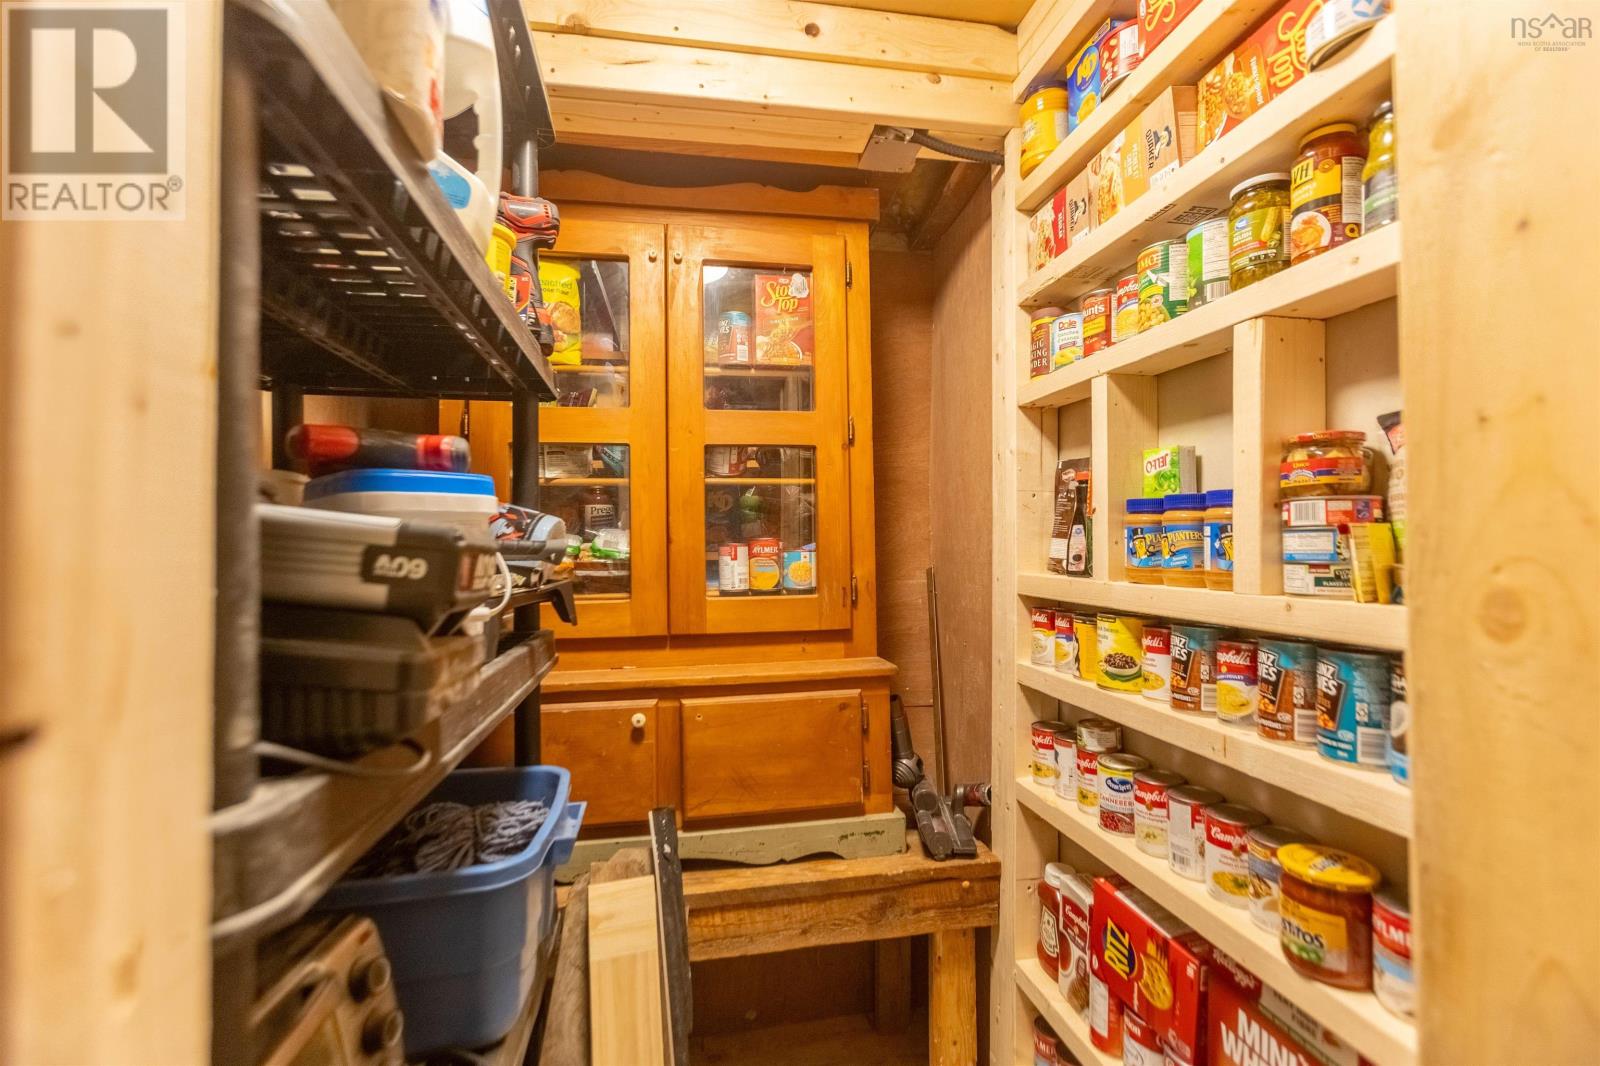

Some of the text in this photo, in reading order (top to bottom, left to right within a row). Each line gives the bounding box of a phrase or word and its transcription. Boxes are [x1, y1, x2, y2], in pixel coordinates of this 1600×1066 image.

[1145, 129, 1154, 170] QUAKER
[1293, 162, 1310, 185] VH
[761, 281, 790, 307] Sto
[774, 296, 798, 313] Top
[1058, 319, 1077, 331] Dole
[1032, 338, 1045, 350] GIC
[1032, 348, 1048, 359] ING
[1032, 358, 1048, 368] DER
[1167, 531, 1203, 543] PLANTERS
[1104, 916, 1130, 981] RITZ
